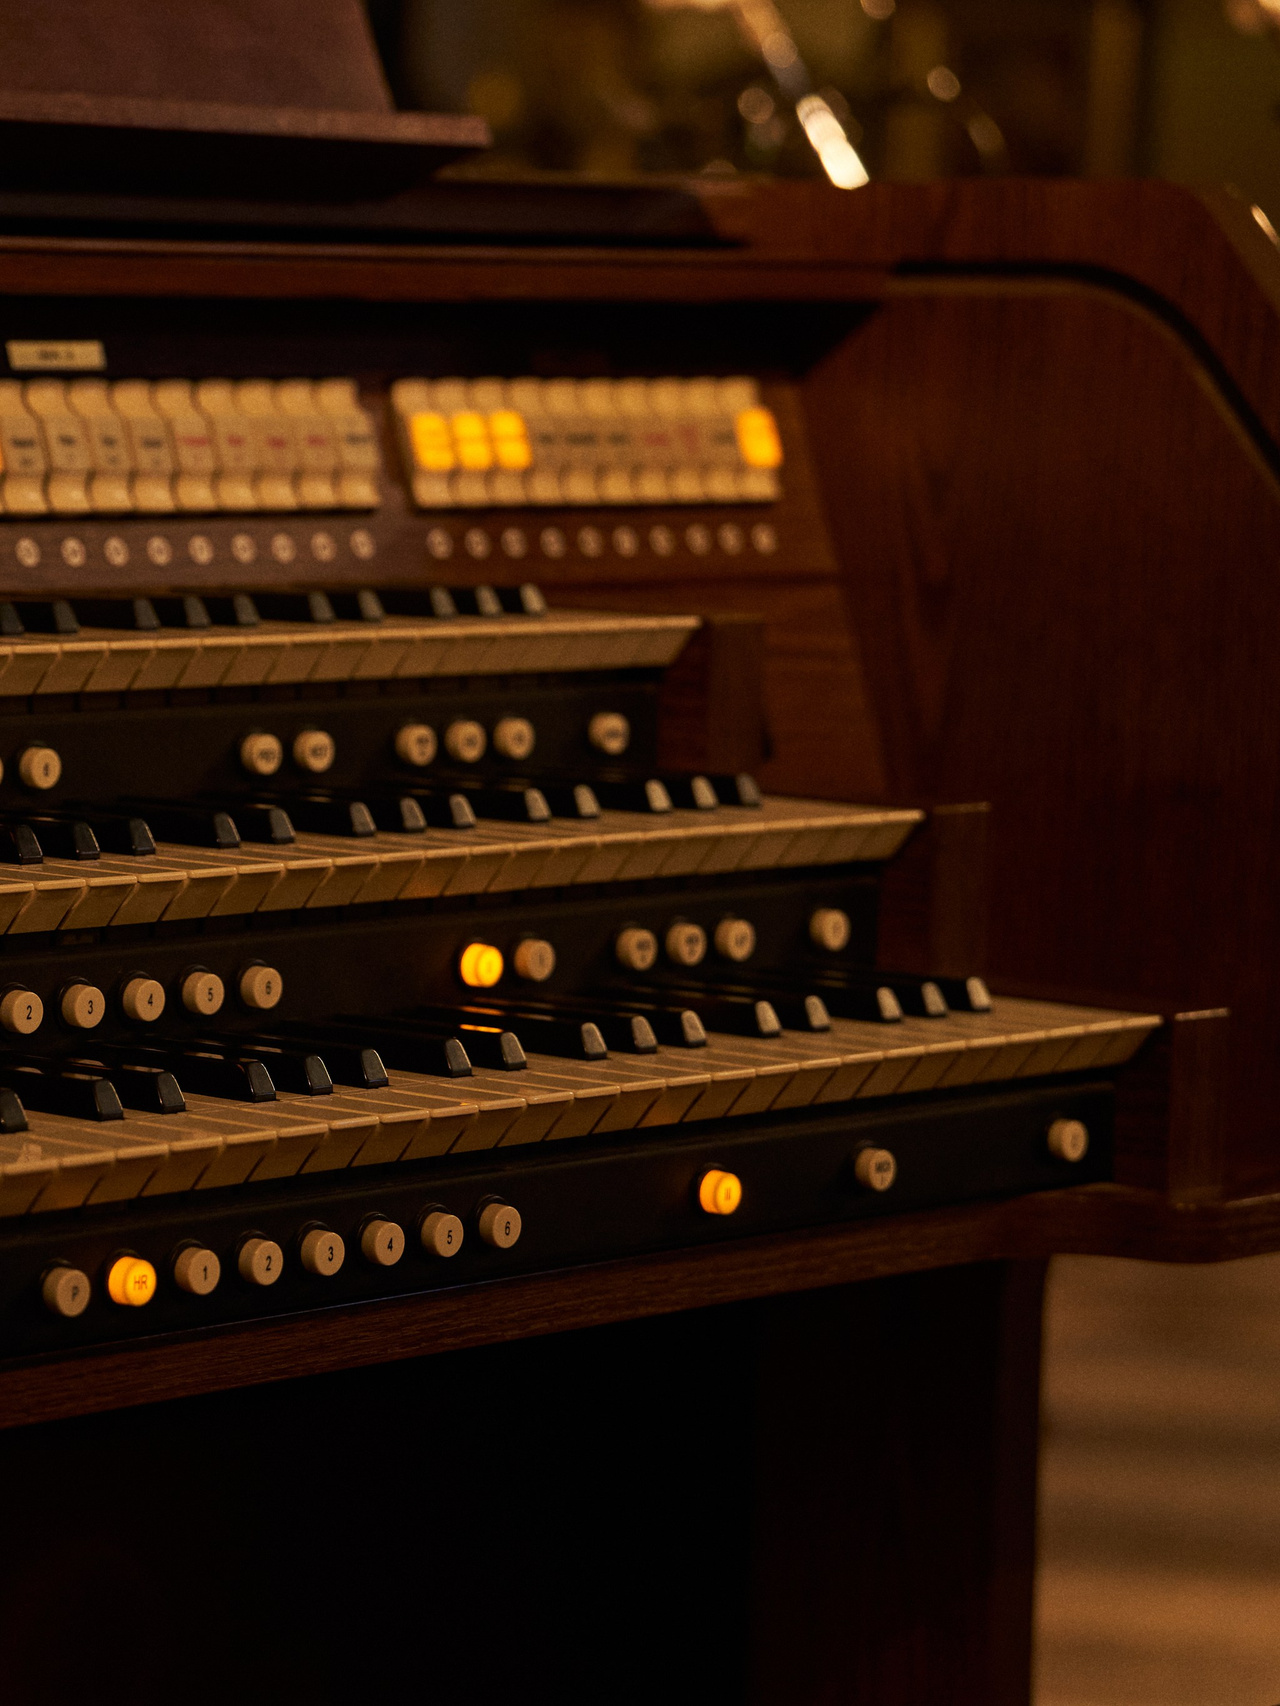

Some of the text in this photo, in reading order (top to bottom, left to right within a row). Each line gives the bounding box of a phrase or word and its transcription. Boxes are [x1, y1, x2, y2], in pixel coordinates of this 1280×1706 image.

[207, 987, 214, 1002] 5
[265, 980, 272, 996] 6
[87, 999, 94, 1015] 3
[147, 993, 154, 1006] 4
[26, 1004, 33, 1021] 2
[504, 1220, 511, 1237] 6
[387, 1237, 394, 1252] 4
[446, 1229, 453, 1245] 5
[327, 1246, 334, 1262] 3
[265, 1255, 272, 1272] 2
[202, 1265, 208, 1281] 1
[133, 1274, 148, 1291] HR
[71, 1285, 80, 1301] P
